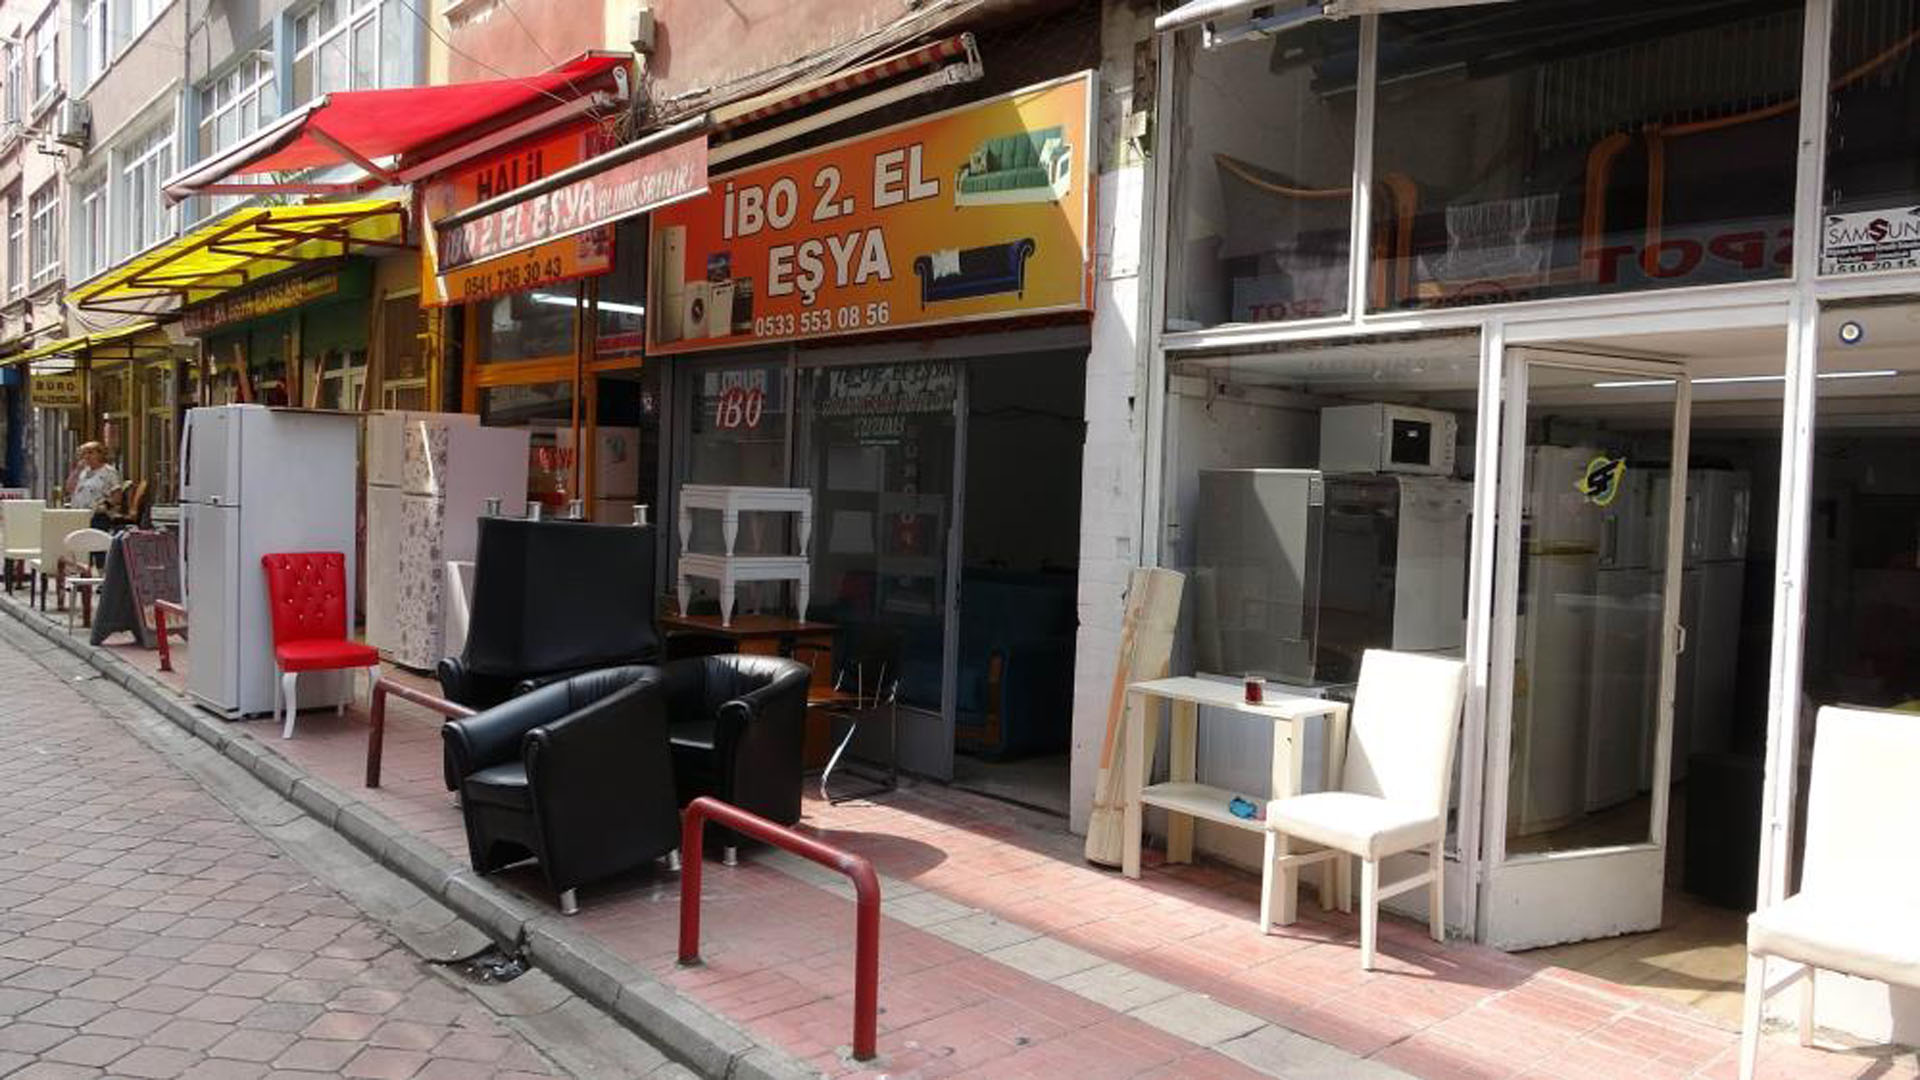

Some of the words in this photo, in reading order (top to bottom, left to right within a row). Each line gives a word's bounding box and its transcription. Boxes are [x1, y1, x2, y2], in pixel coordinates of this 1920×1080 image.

[722, 176, 799, 241] İBO
[813, 164, 856, 221] 2.
[872, 143, 941, 210] EL
[523, 260, 541, 285] 30
[545, 256, 562, 278] 43
[767, 226, 892, 305] EŞYA
[754, 312, 795, 339] 0533
[800, 308, 832, 334] 553
[838, 305, 860, 330] 08
[865, 301, 890, 326] 56
